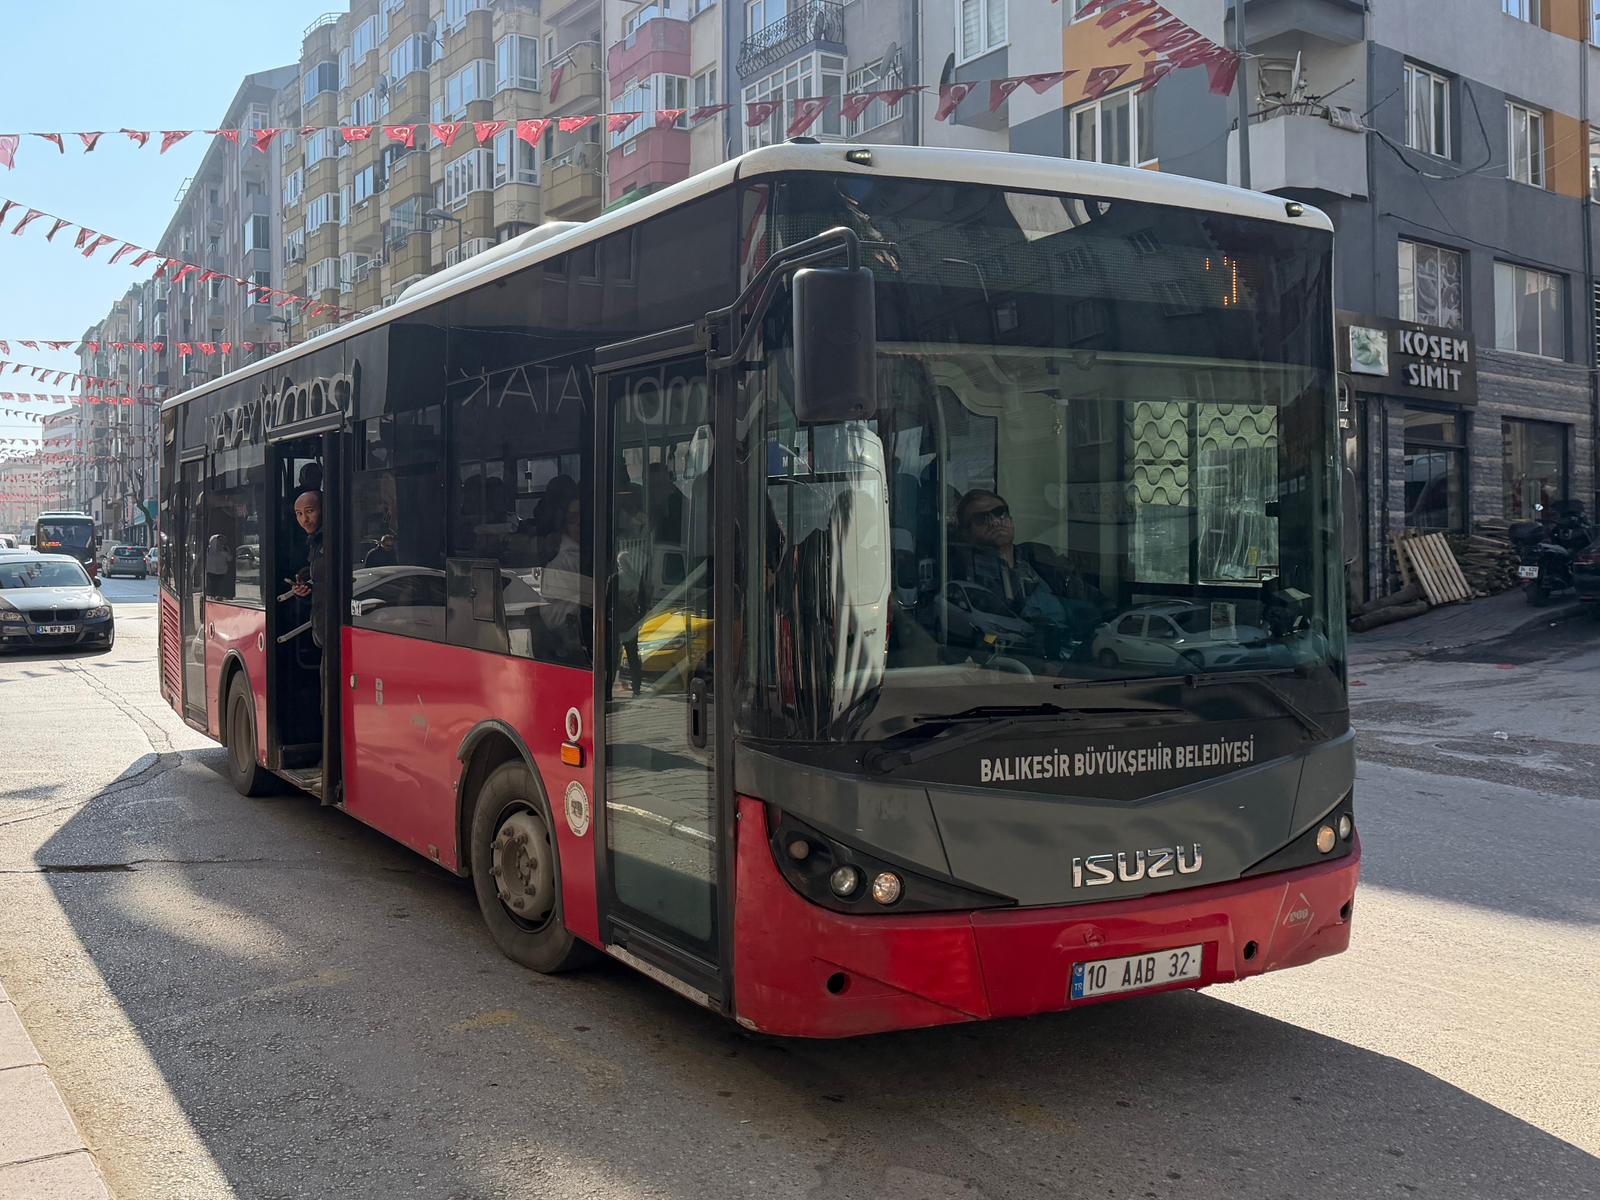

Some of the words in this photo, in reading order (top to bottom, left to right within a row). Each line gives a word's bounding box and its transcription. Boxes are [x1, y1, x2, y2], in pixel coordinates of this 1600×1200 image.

[1399, 326, 1469, 363] KÖŞEM
[1408, 358, 1462, 392] SİMİT
[980, 748, 1070, 783] BALIKESİR
[1074, 742, 1172, 777] BÜYÜKŞEHİR
[1175, 734, 1254, 769] BELEDİYESİ
[1072, 843, 1203, 888] ISUZU
[1088, 964, 1107, 991] 10
[1121, 957, 1156, 987] AAB
[1168, 951, 1190, 978] 32
